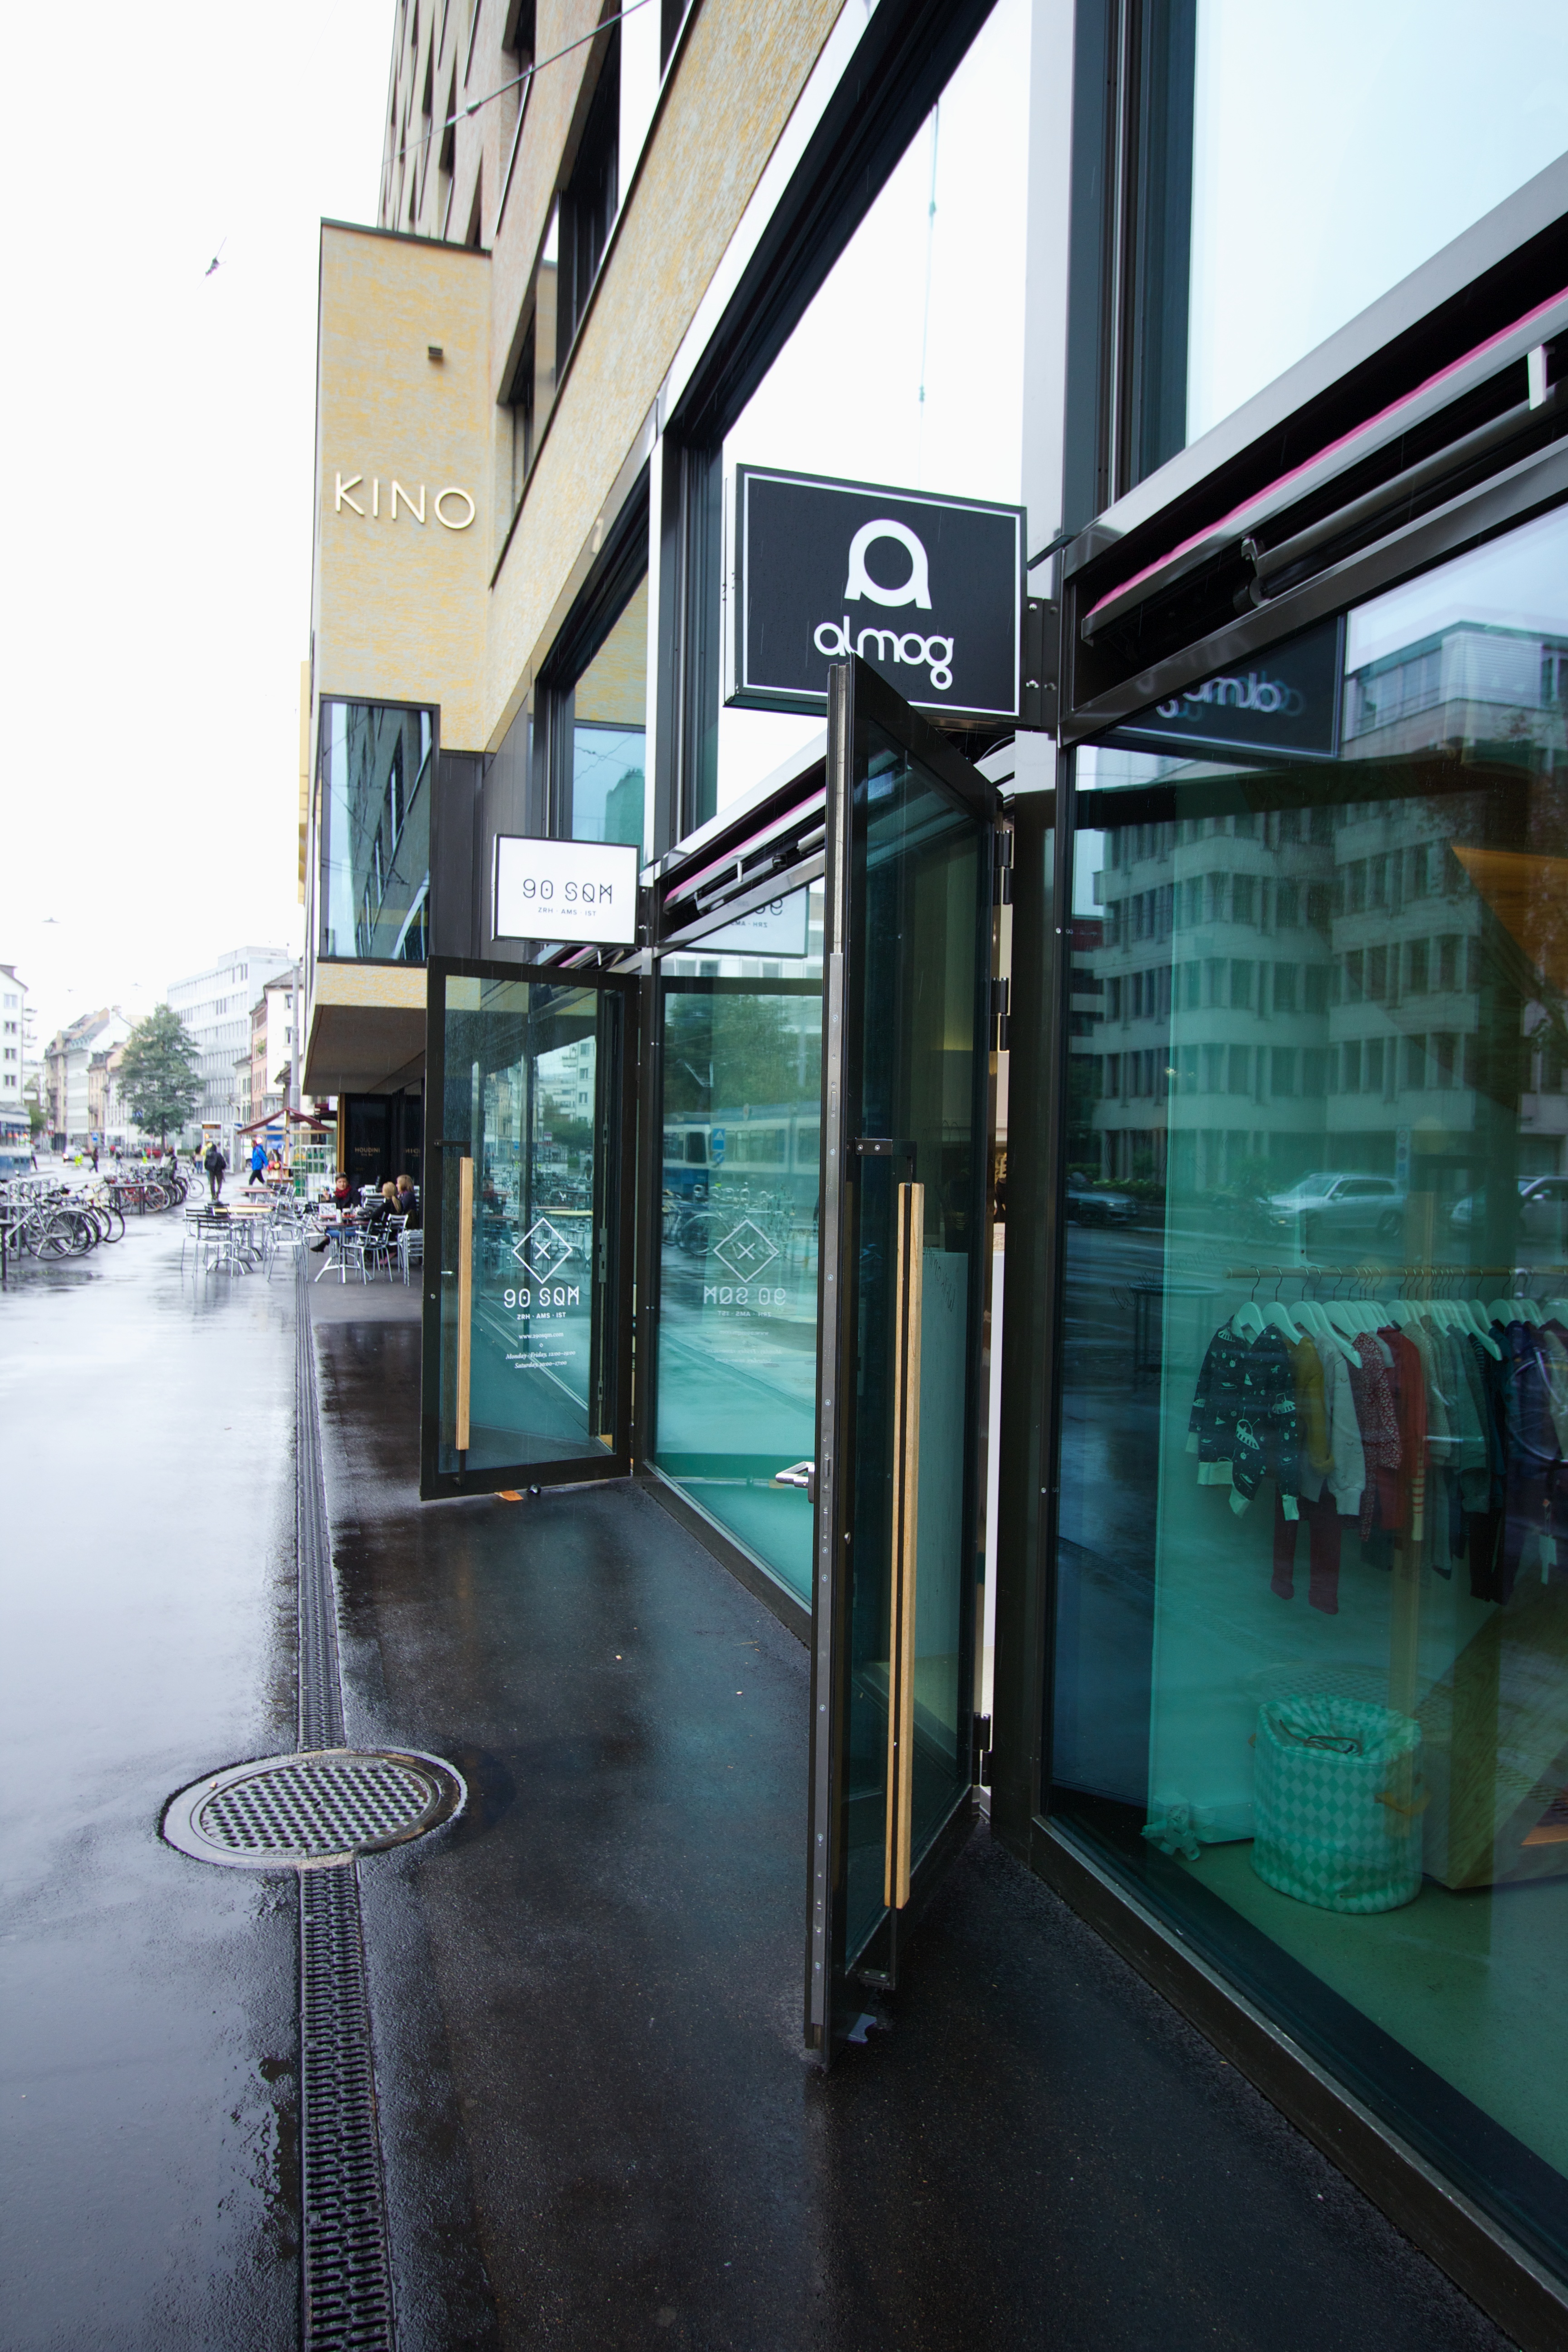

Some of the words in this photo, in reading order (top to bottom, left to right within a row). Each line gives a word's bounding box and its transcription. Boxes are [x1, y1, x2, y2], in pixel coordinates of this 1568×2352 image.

[335, 471, 475, 529] KINO
[813, 615, 954, 691] almog
[523, 878, 553, 900] 90
[565, 882, 612, 904] SQM
[504, 1289, 530, 1308] 90
[539, 1285, 579, 1307] SQM
